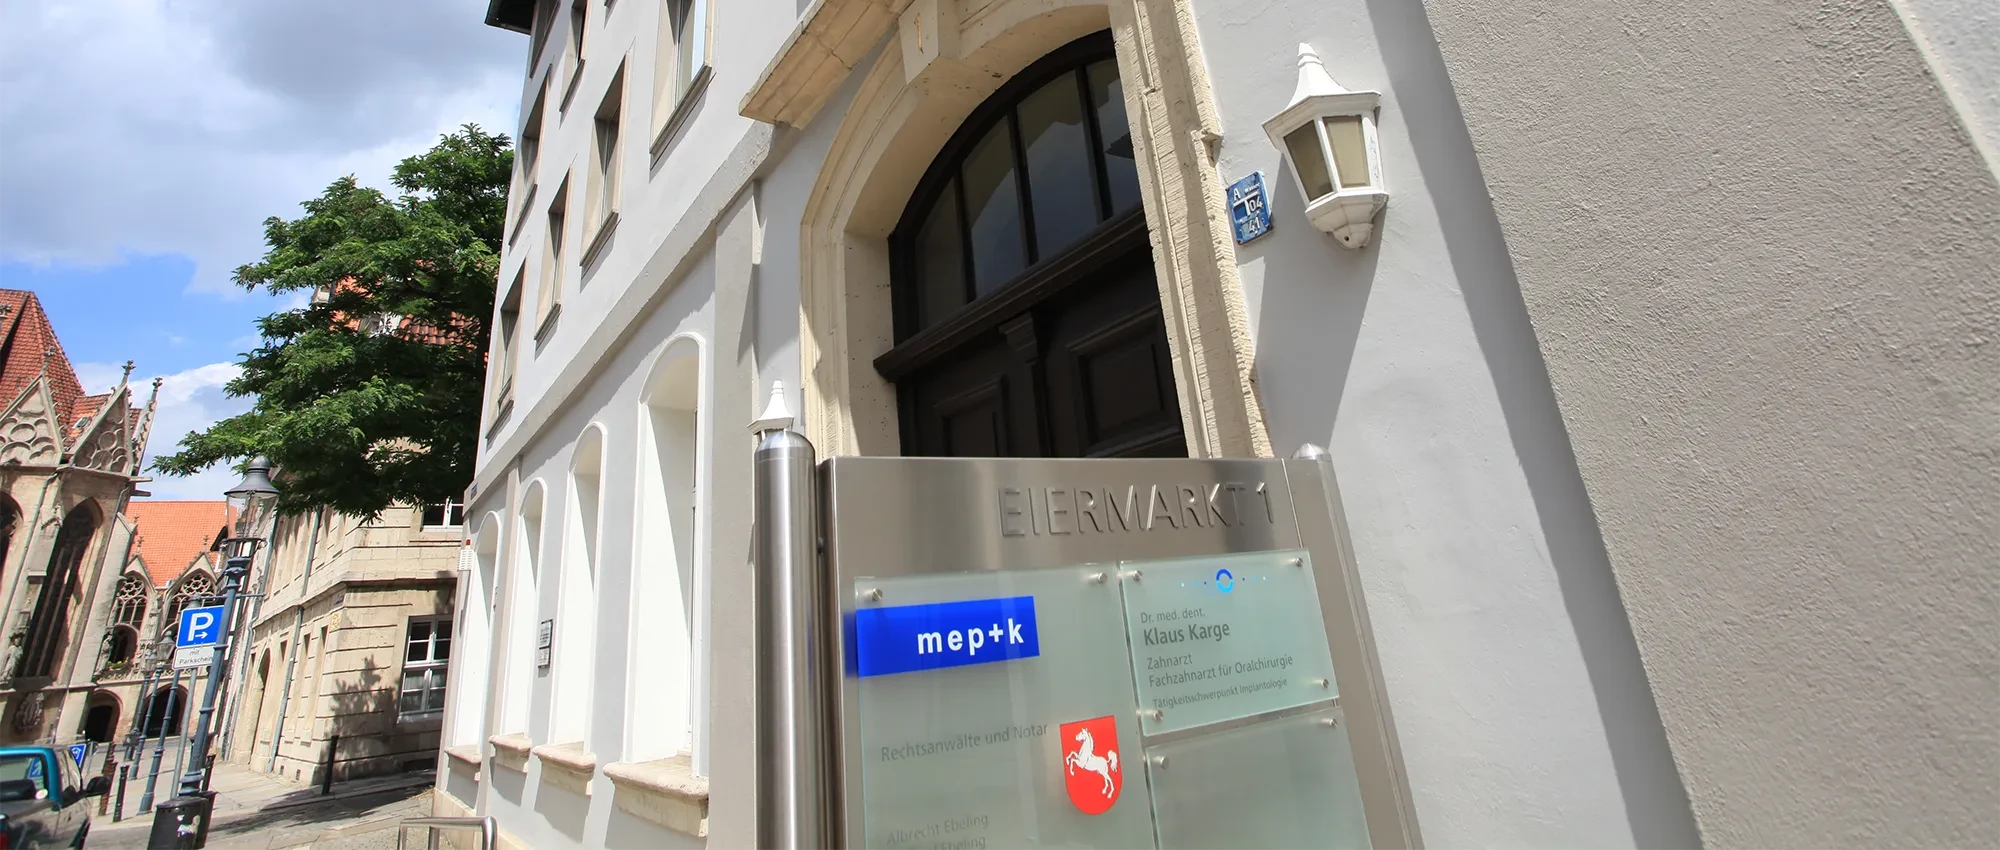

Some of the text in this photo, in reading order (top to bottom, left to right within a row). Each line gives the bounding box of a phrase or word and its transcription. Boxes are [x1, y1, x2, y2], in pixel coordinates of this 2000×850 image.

[1234, 187, 1241, 201] A
[997, 481, 1273, 537] EIERMARKT 1
[188, 612, 214, 641] P
[1141, 607, 1206, 624] Dr. med. dent.
[917, 618, 1024, 656] mep+k
[1143, 623, 1230, 646] Klaus Karge
[1146, 653, 1192, 670] Zahnarzt
[1149, 654, 1293, 688] Fachzahnarzt für Oralchirurgie
[1239, 677, 1287, 695] Implantologie
[881, 723, 1048, 762] Rechtsanwälte und Notar
[886, 814, 989, 846] Albrecht Ebeling
